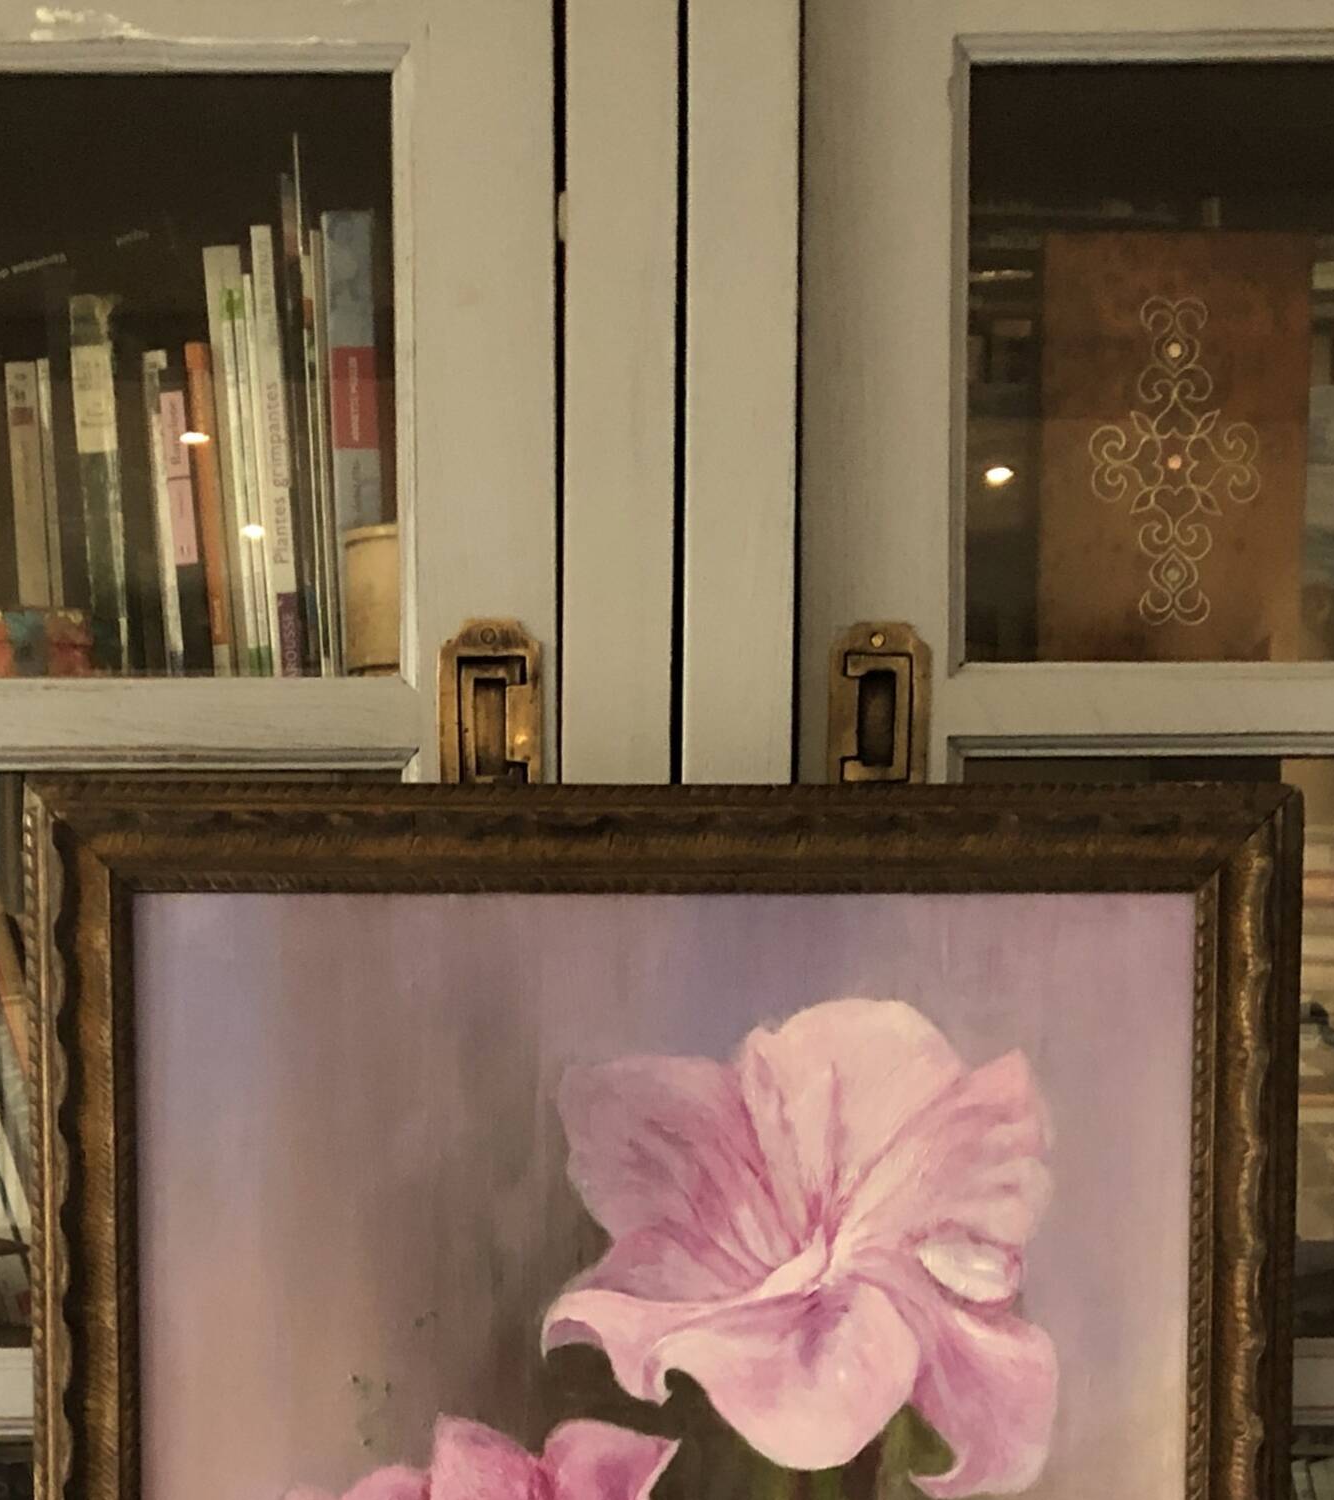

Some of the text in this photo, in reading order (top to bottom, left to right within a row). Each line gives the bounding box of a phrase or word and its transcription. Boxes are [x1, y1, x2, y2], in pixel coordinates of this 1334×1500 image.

[260, 381, 292, 488] grimpantes
[264, 495, 292, 565] Plantes
[280, 611, 305, 677] AROUSSE
